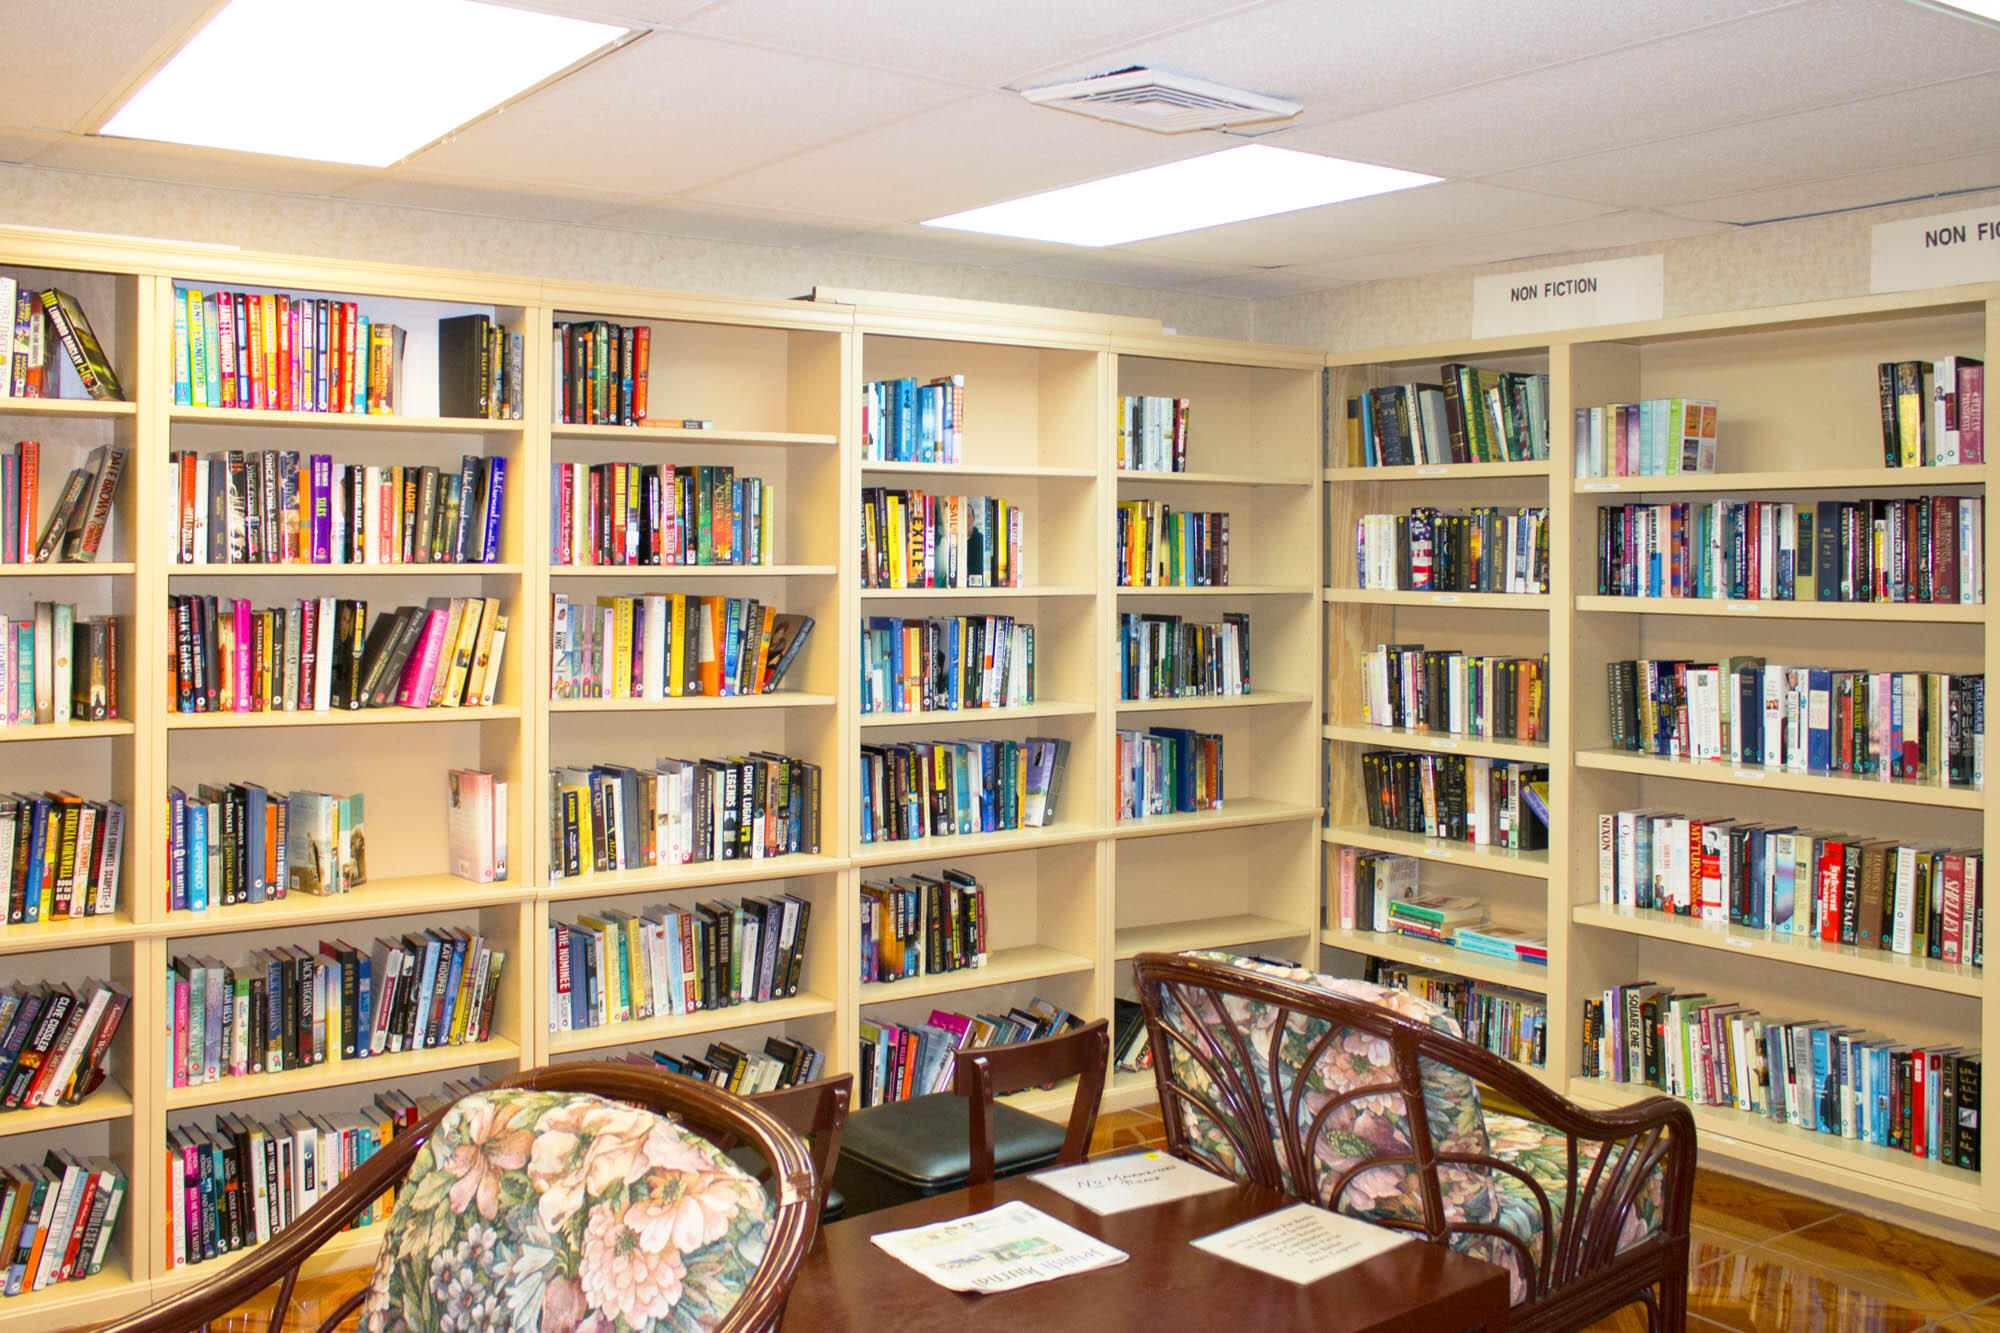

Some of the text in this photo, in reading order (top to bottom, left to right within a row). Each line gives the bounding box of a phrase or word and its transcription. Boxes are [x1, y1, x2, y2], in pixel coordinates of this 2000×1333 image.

[1925, 225, 1966, 248] NON
[1511, 277, 1597, 302] NON FICTION
[194, 332, 204, 384] EVANOVICH
[94, 451, 123, 519] DALE BROWN
[405, 482, 416, 513] ALONE
[490, 485, 502, 518] Garwood
[316, 497, 327, 517] SILKS
[950, 504, 958, 528] SAIL
[912, 517, 924, 568] EXILE
[181, 644, 192, 672] GAME
[725, 768, 736, 808] LEGENDS
[742, 765, 753, 826] CHUCK LOGAN
[195, 811, 204, 839] JAMES
[226, 803, 234, 833] BROKER
[1602, 817, 1611, 851] NIXON
[1692, 825, 1701, 844] MY
[60, 809, 79, 878] PATRICIA CORNWELL
[79, 813, 95, 876] PATRICIA CORNWELL
[106, 811, 121, 866] PATRICIA CORNWELL
[1692, 844, 1701, 877] TURN
[1829, 865, 1840, 911] Indecent
[1846, 866, 1856, 900] CHILD
[969, 898, 977, 923] Airtight
[1944, 877, 1961, 938] SHELLEY
[435, 943, 452, 994] KAY HOOPER
[559, 930, 570, 991] THE NOMINEE
[302, 960, 313, 1016] JACK HIGGINS
[35, 996, 70, 1052] CLIVE CUSSLER
[224, 1005, 232, 1023] HESS
[1584, 1018, 1592, 1044] ESCAPE
[1629, 994, 1640, 1048] SQUARE ONE
